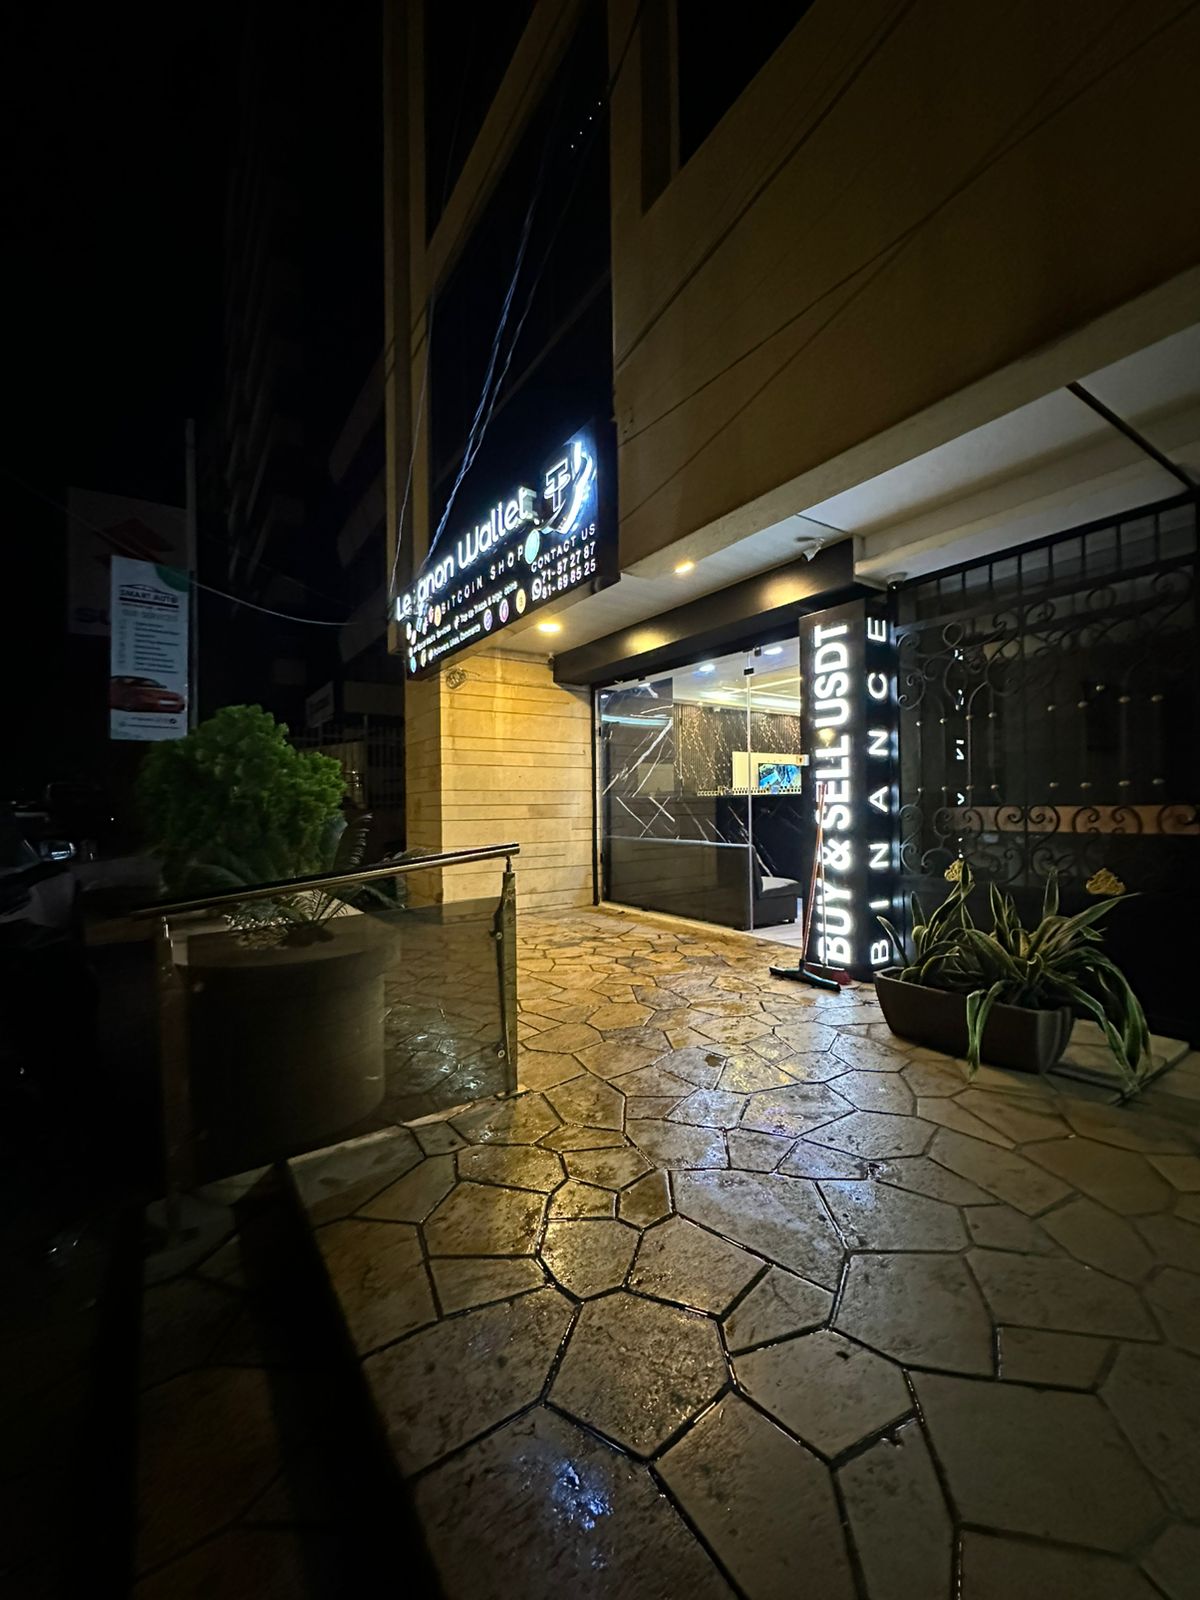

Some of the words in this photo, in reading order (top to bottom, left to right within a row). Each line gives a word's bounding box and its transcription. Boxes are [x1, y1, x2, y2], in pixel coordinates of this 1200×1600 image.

[441, 576, 483, 615] BITCOIN
[489, 545, 523, 580] SHOP
[531, 535, 577, 573] CONTACT
[581, 523, 596, 541] US
[570, 549, 582, 568] 27
[584, 558, 596, 576] 25
[814, 624, 850, 728] USDT
[815, 735, 850, 831] SELL
[867, 617, 889, 965] BINANCE
[817, 840, 850, 871] &
[817, 886, 850, 965] BUY
